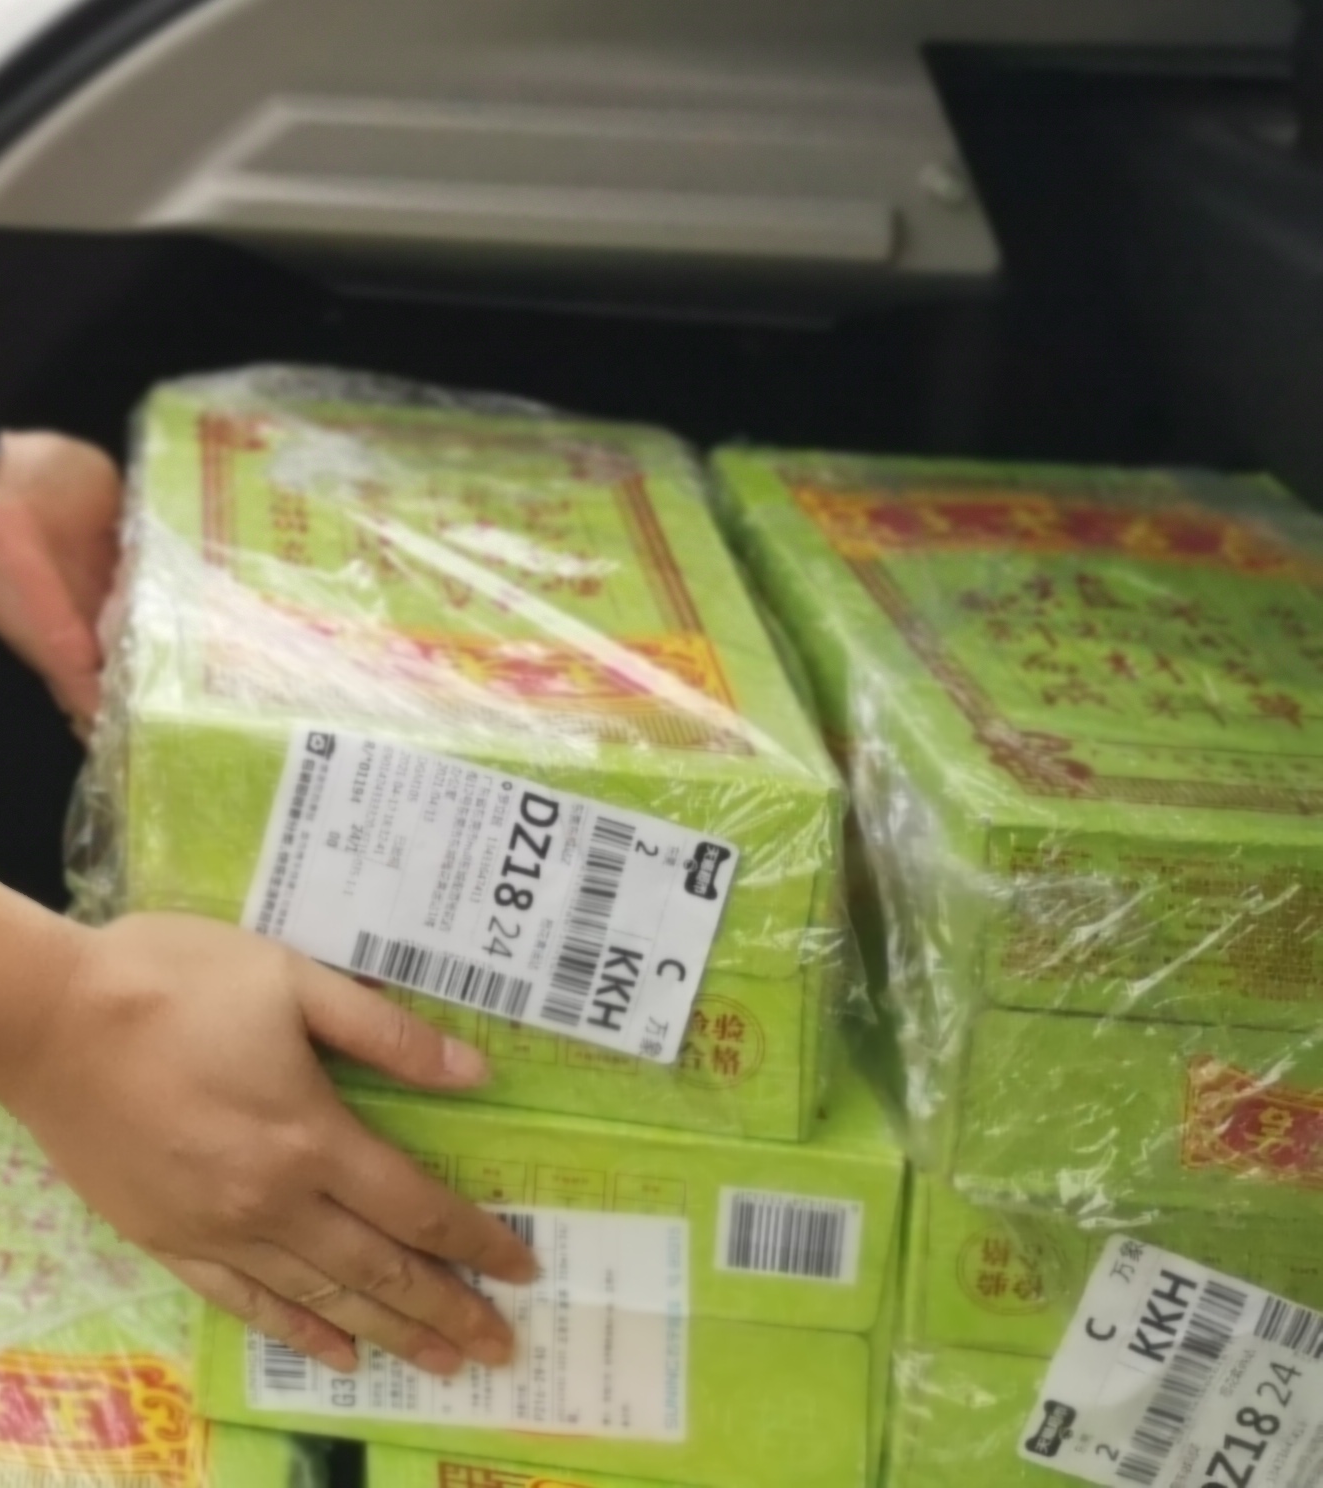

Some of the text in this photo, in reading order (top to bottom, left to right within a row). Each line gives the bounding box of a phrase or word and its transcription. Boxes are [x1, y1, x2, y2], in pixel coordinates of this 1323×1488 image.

[490, 790, 563, 914] DZ18
[634, 839, 660, 858] 2
[479, 914, 523, 961] 24
[585, 944, 644, 1033] KKH
[655, 955, 688, 983] C
[1110, 1240, 1145, 1284] 万象
[1085, 1317, 1117, 1341] C
[1127, 1269, 1198, 1363] KKH
[1256, 1361, 1303, 1408] 24
[1095, 1443, 1120, 1462] 2
